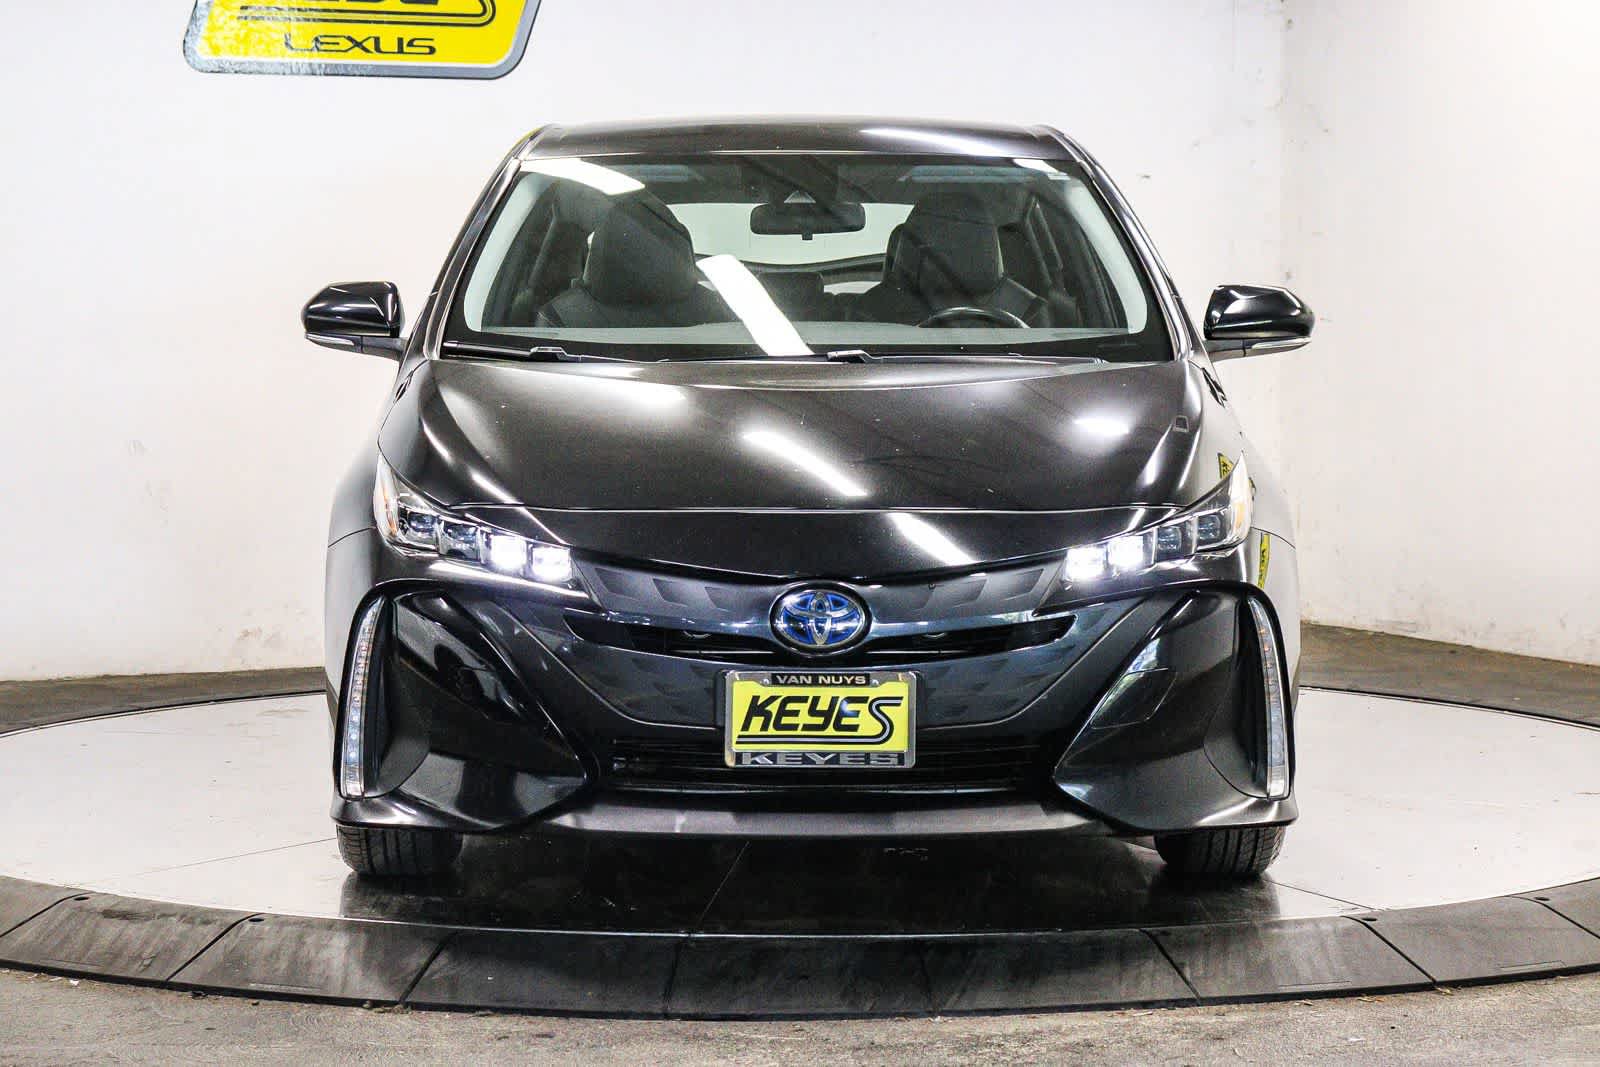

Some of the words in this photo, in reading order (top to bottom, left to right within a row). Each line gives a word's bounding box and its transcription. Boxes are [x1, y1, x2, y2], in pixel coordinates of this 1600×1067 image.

[285, 33, 437, 56] LEXUS
[776, 675, 815, 684] VAN
[819, 675, 867, 685] NUYS
[737, 695, 904, 746] KEYES
[741, 752, 899, 765] KEYES
